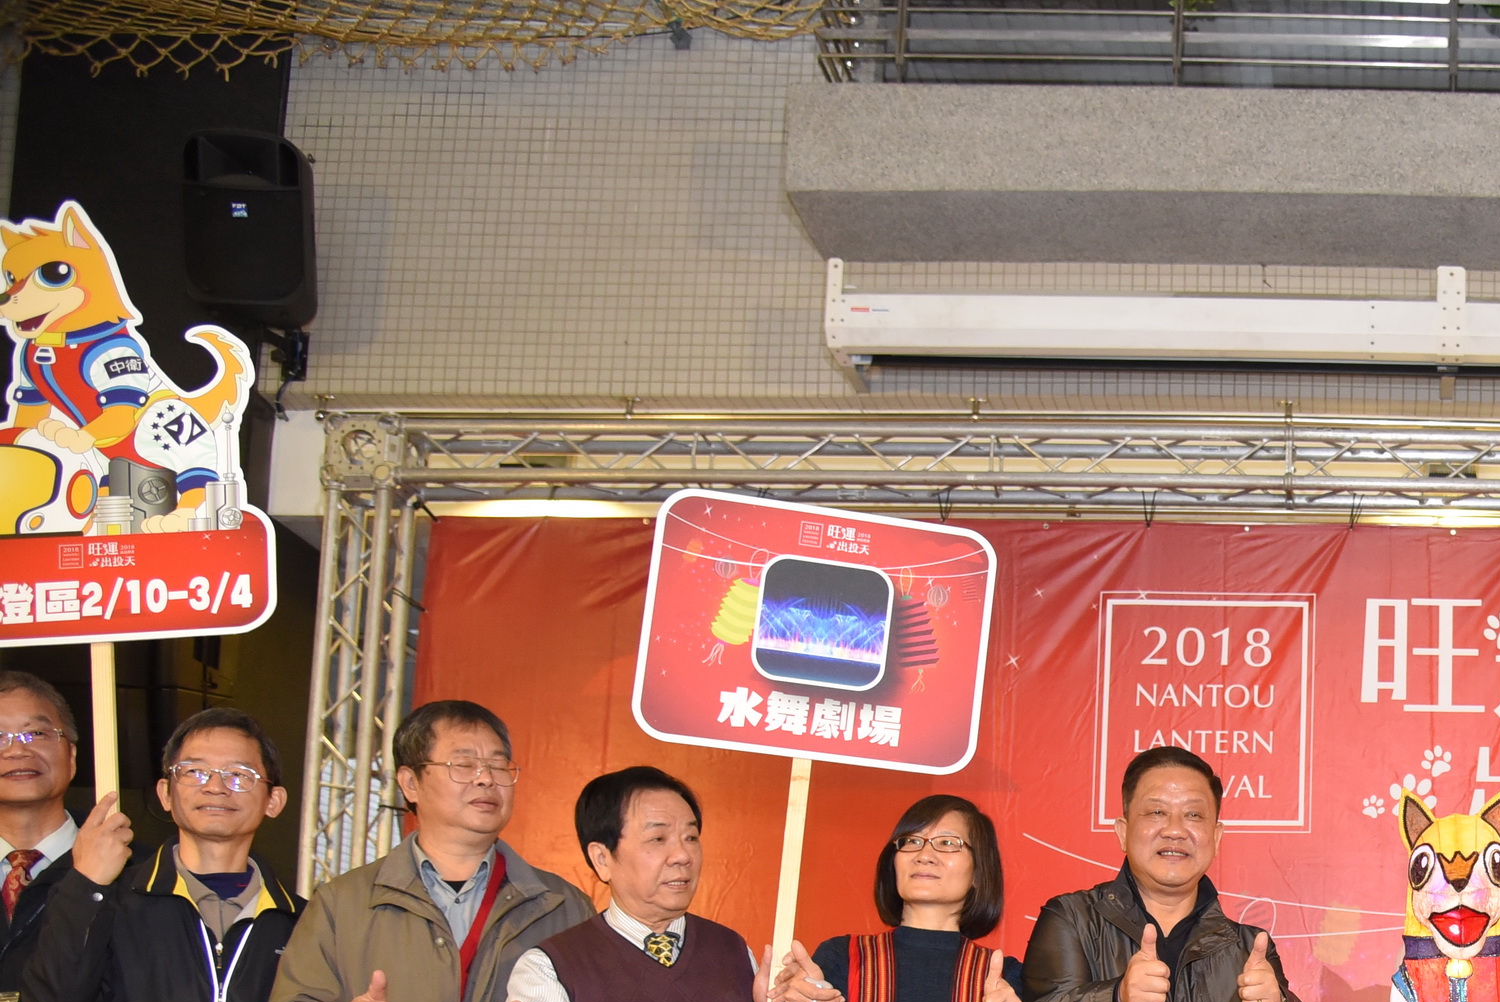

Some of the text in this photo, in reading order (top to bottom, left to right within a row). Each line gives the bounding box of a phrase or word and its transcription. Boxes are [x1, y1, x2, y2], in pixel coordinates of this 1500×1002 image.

[109, 358, 143, 374] 中衛
[1141, 626, 1272, 667] 2018
[1136, 683, 1274, 708] NANTOU
[717, 686, 901, 747] 水舞劇場
[1134, 729, 1273, 754] LANTERN
